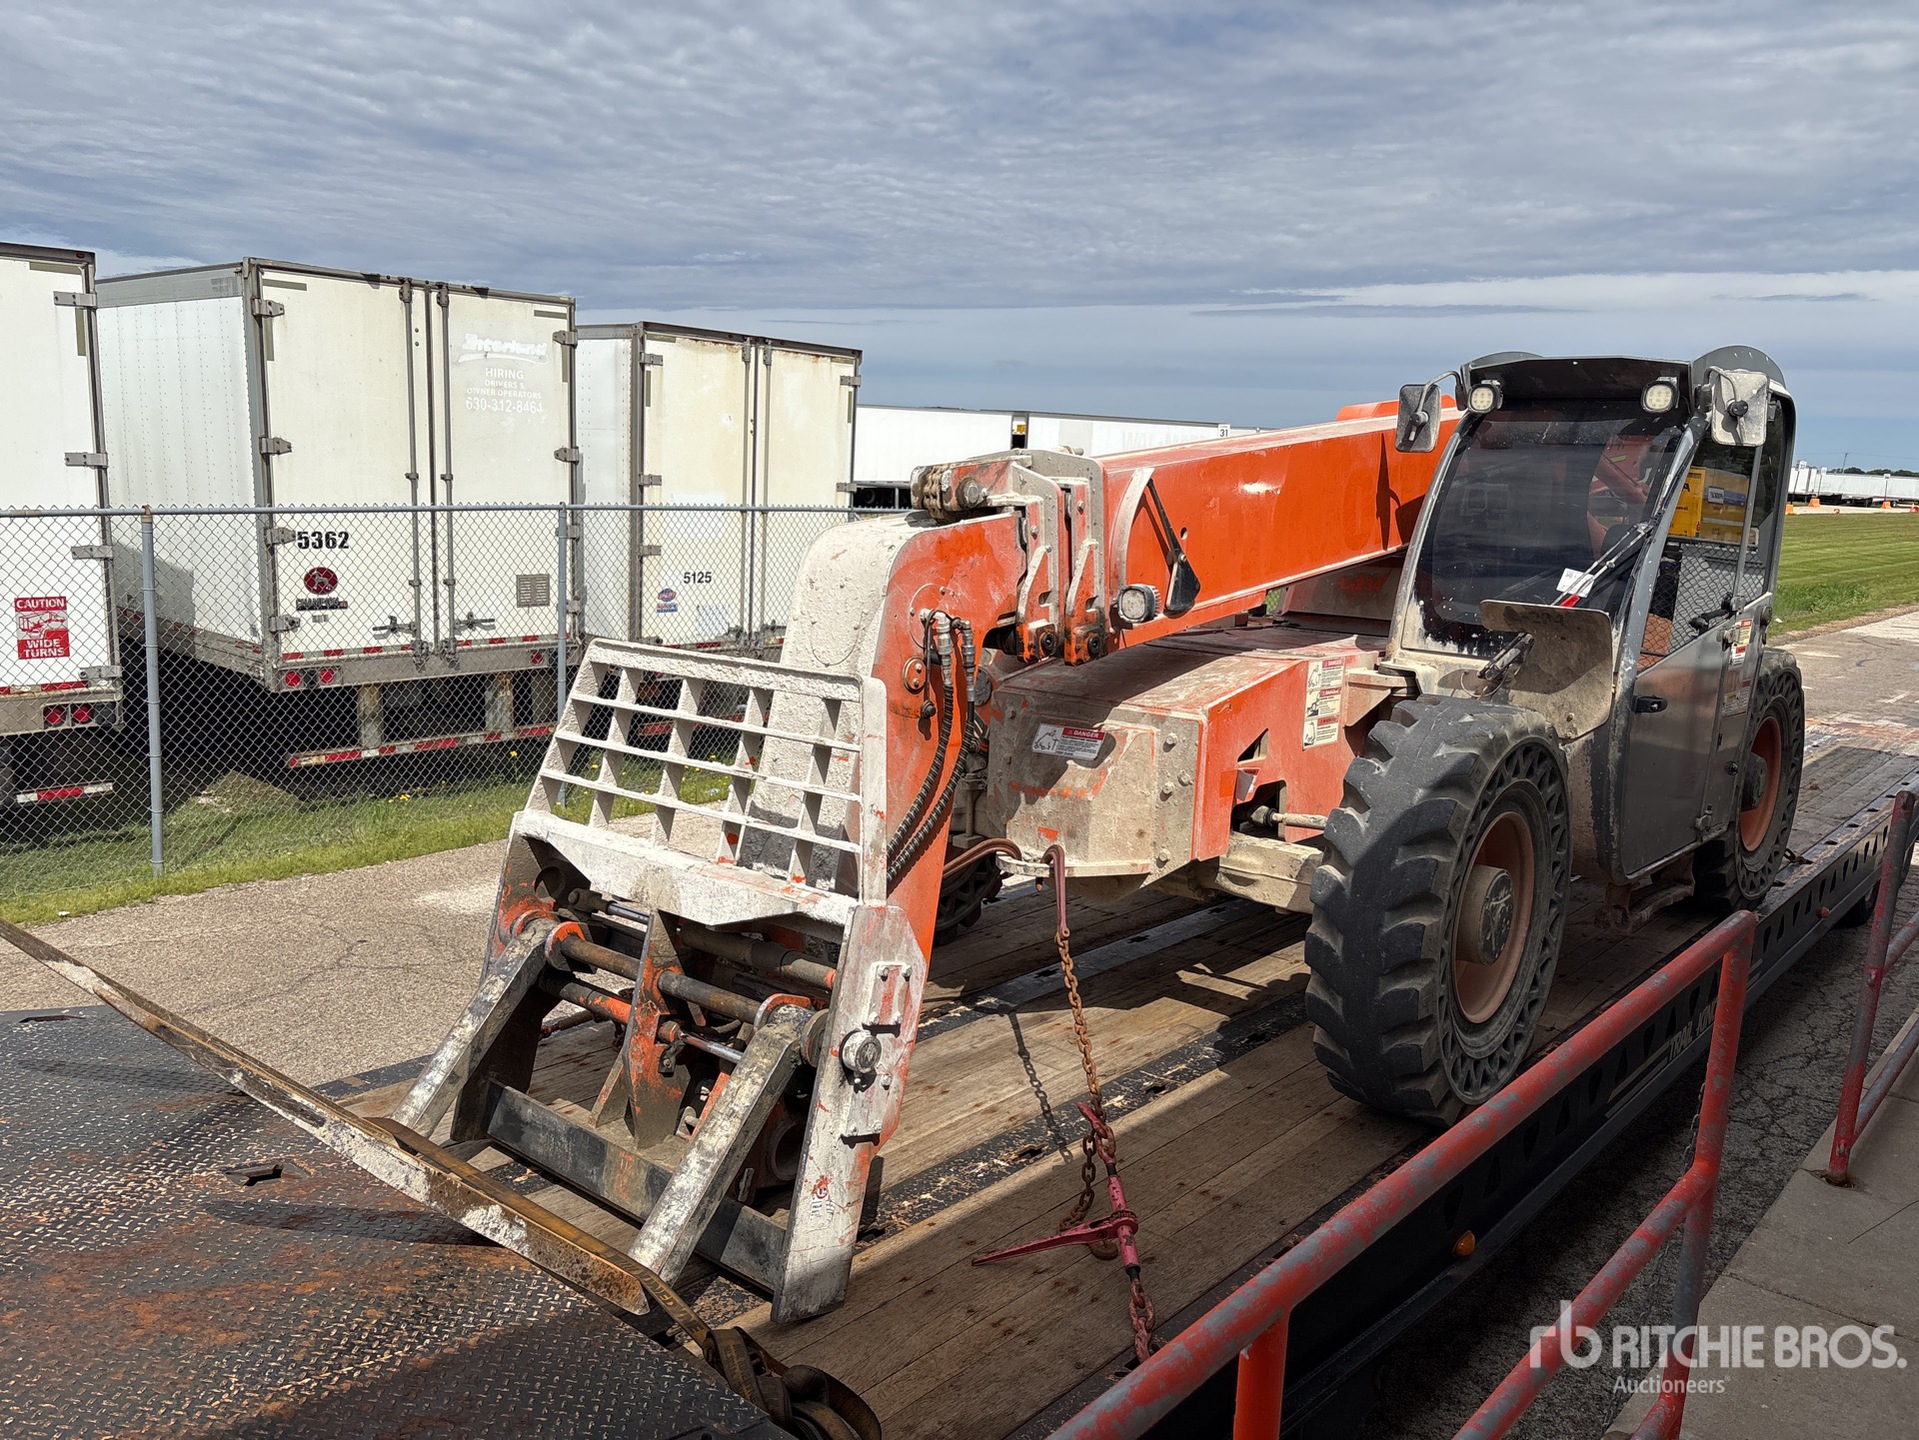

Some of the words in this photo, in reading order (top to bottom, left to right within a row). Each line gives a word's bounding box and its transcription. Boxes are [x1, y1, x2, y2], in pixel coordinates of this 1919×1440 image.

[485, 368, 524, 380] HIRING
[484, 380, 518, 389] DRIVERS
[466, 387, 496, 396] OWNER
[497, 389, 542, 399] OPERATORS
[1219, 429, 1228, 438] 31
[297, 531, 349, 550] 5362
[683, 571, 712, 584] 5125
[16, 598, 65, 609] CAUTION
[27, 639, 60, 649] WIDE
[24, 648, 65, 658] TURNS
[1073, 729, 1099, 739] DANGER
